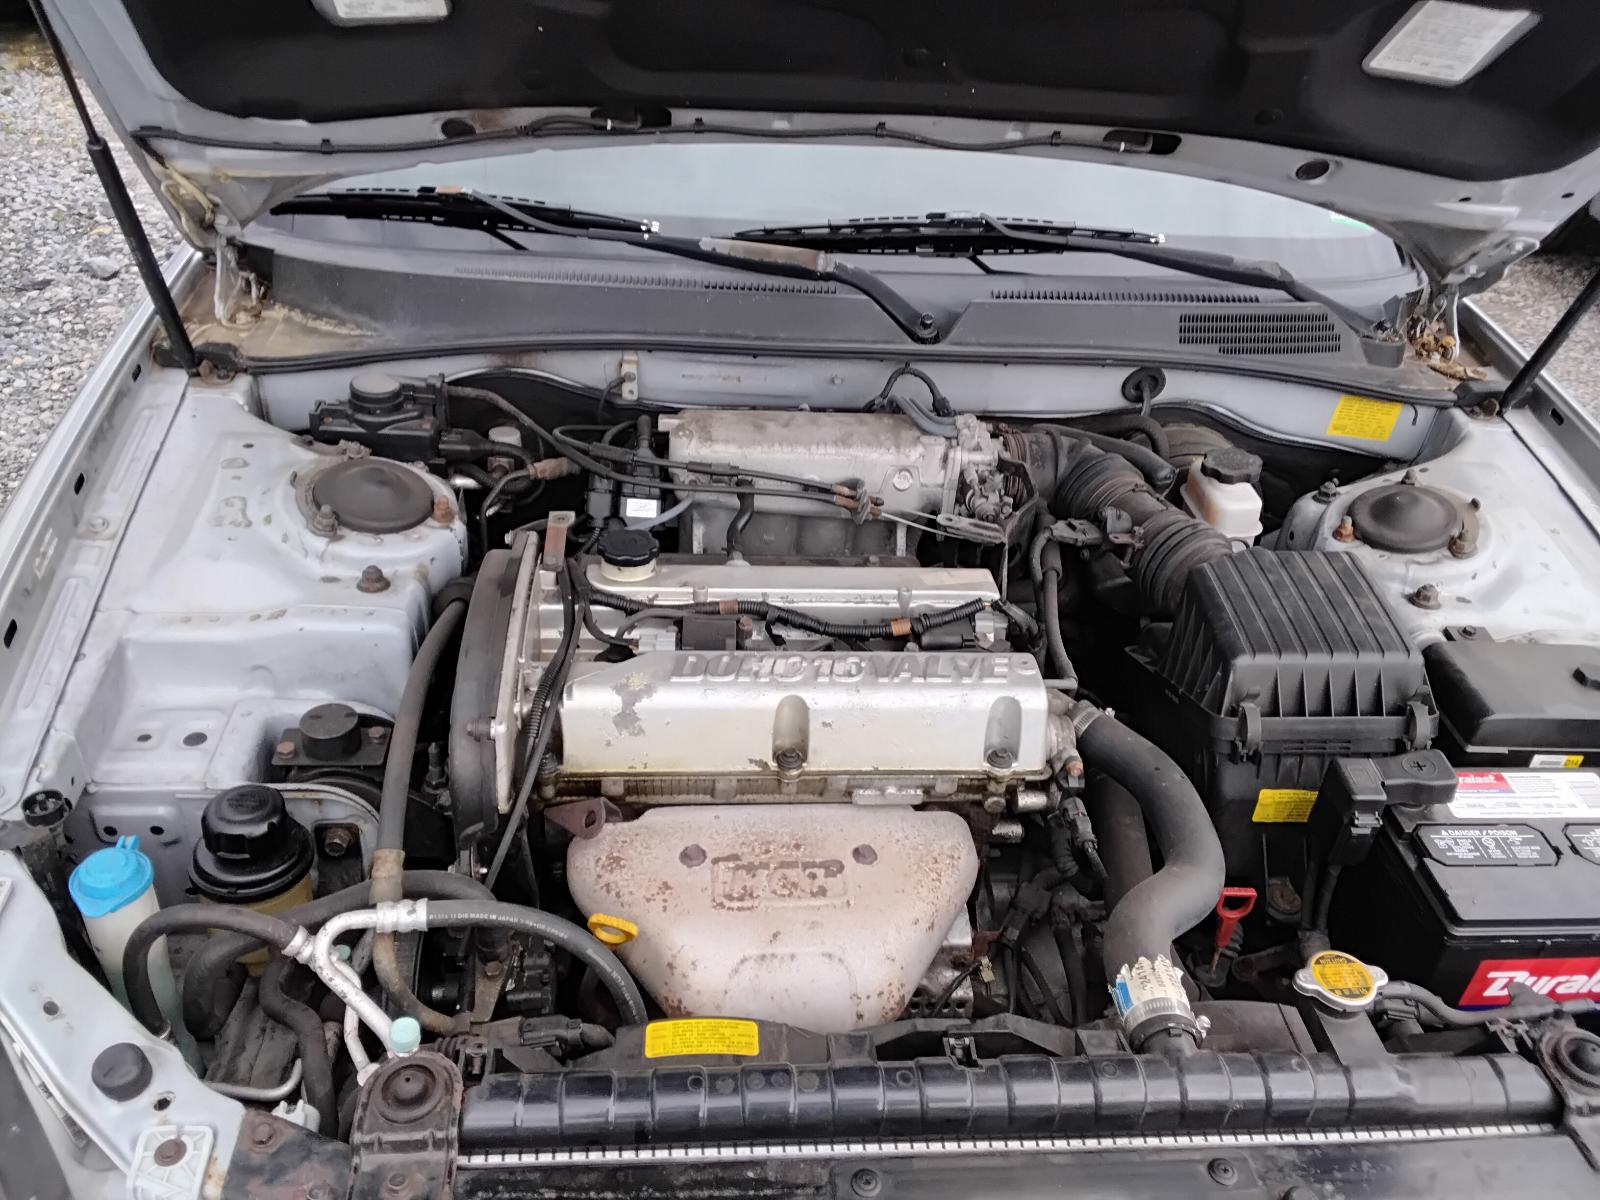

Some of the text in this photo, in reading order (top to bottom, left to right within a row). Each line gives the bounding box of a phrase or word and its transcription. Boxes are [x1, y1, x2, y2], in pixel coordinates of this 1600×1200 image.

[869, 655, 1009, 683] VALVE
[1458, 774, 1497, 784] ralast
[1482, 967, 1600, 996] Dural
